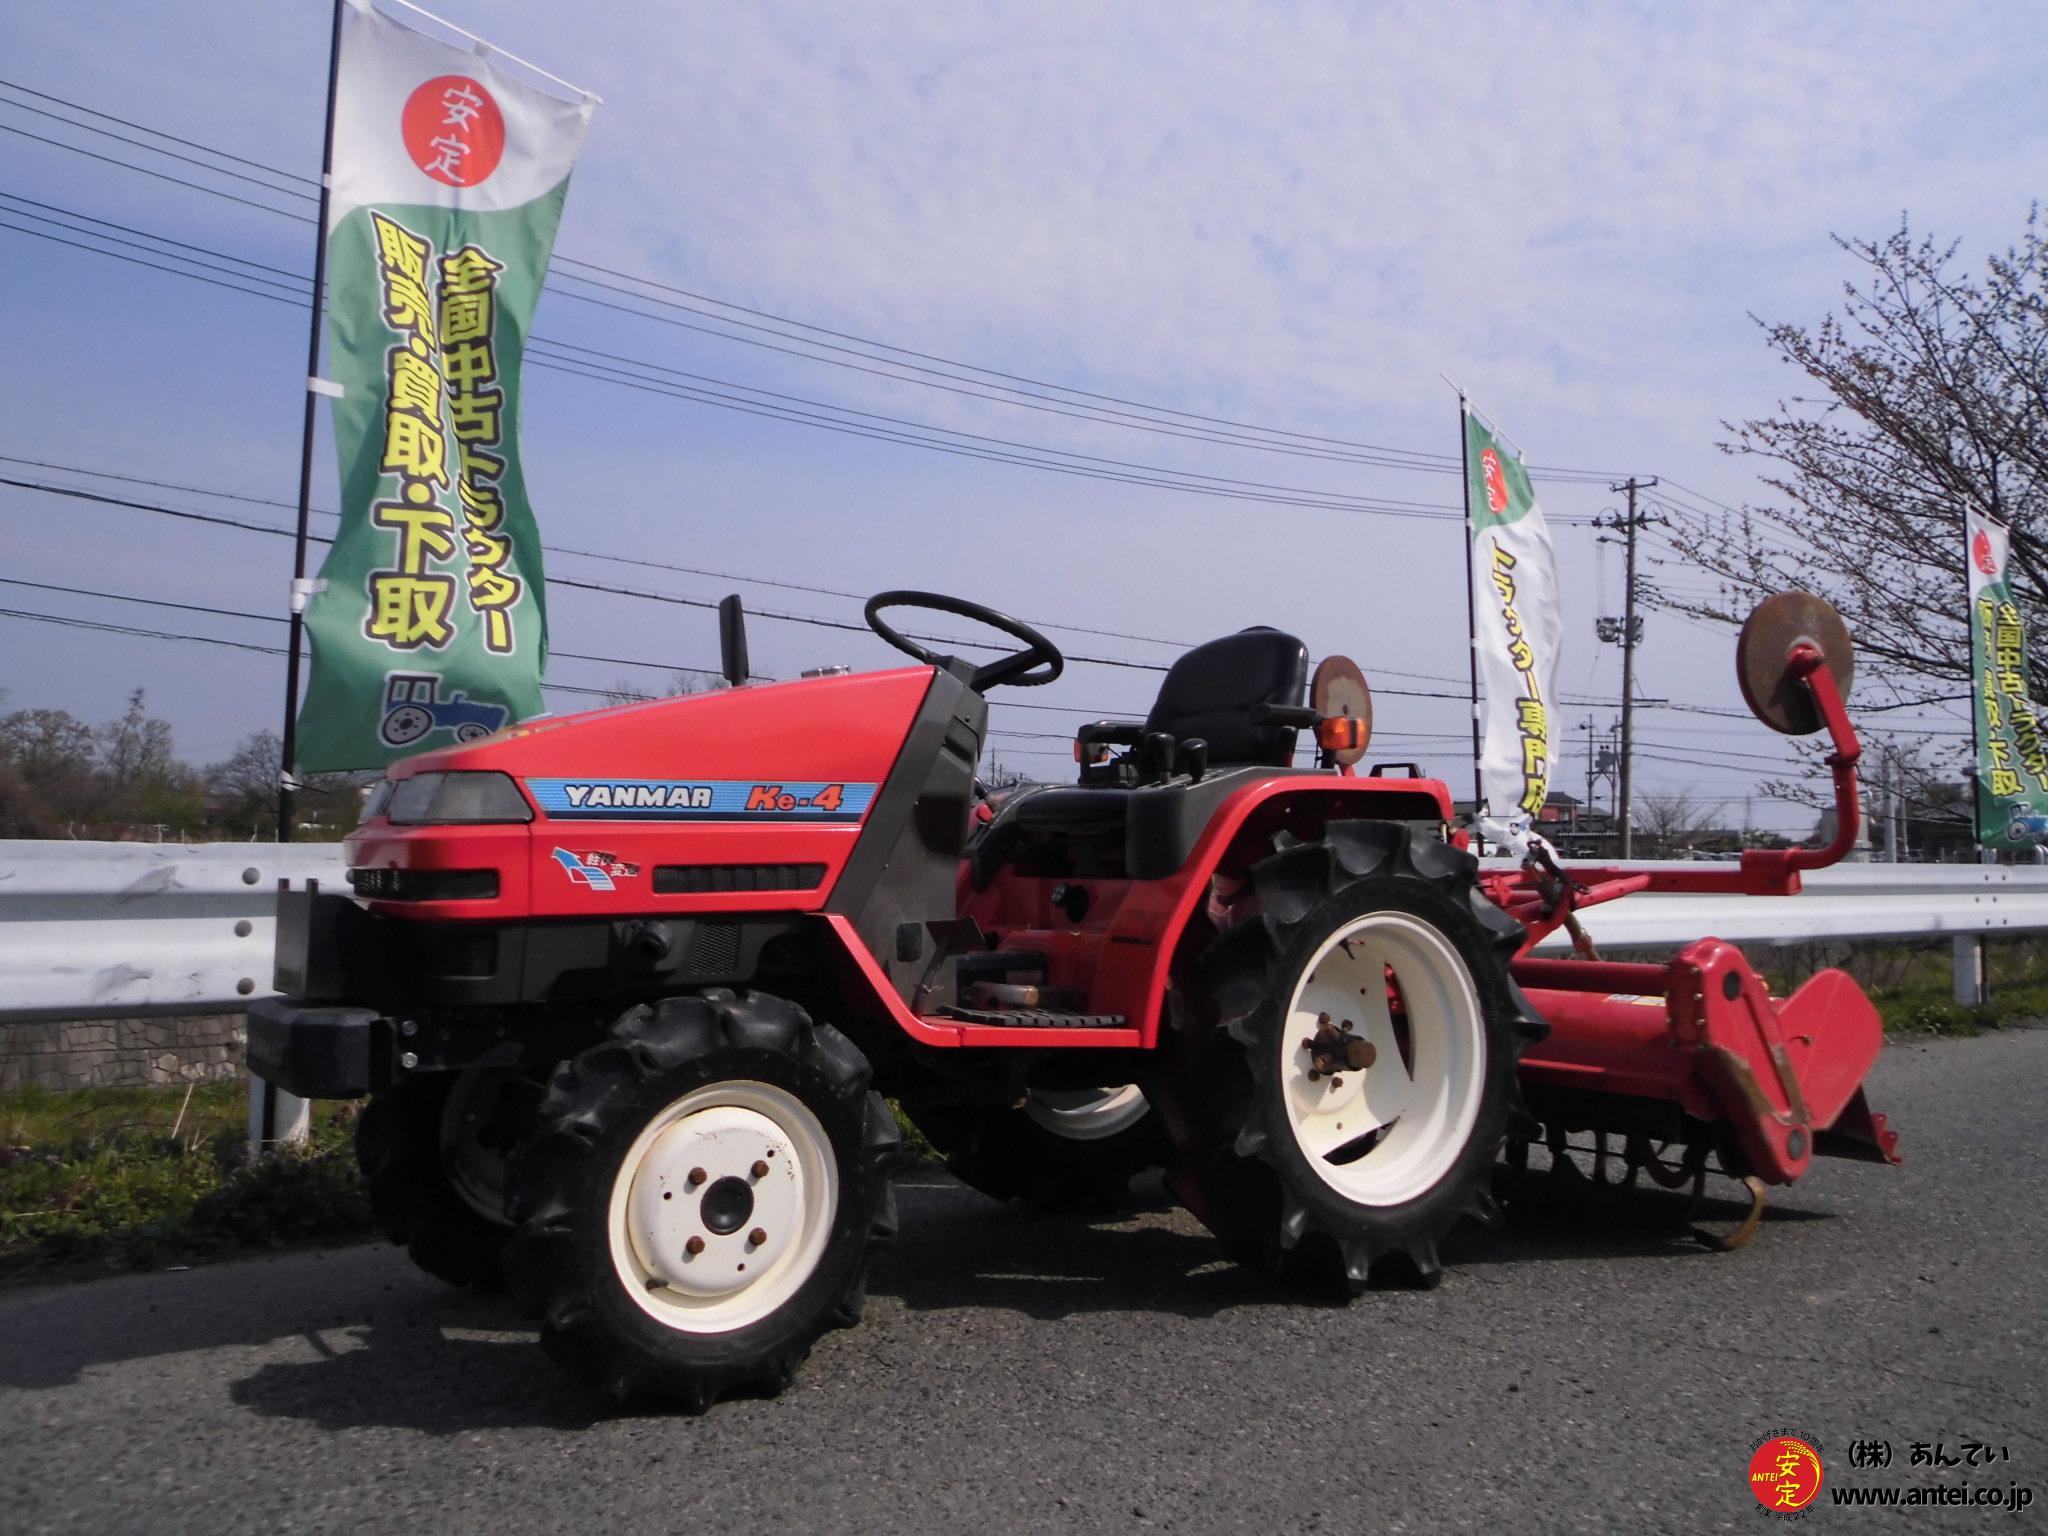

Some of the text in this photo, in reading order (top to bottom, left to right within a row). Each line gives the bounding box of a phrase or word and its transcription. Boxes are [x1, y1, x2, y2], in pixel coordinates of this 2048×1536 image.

[424, 84, 484, 184] 安定
[437, 245, 523, 653] 全国中古トラクター
[565, 784, 843, 811] YANMAR Ke-4
